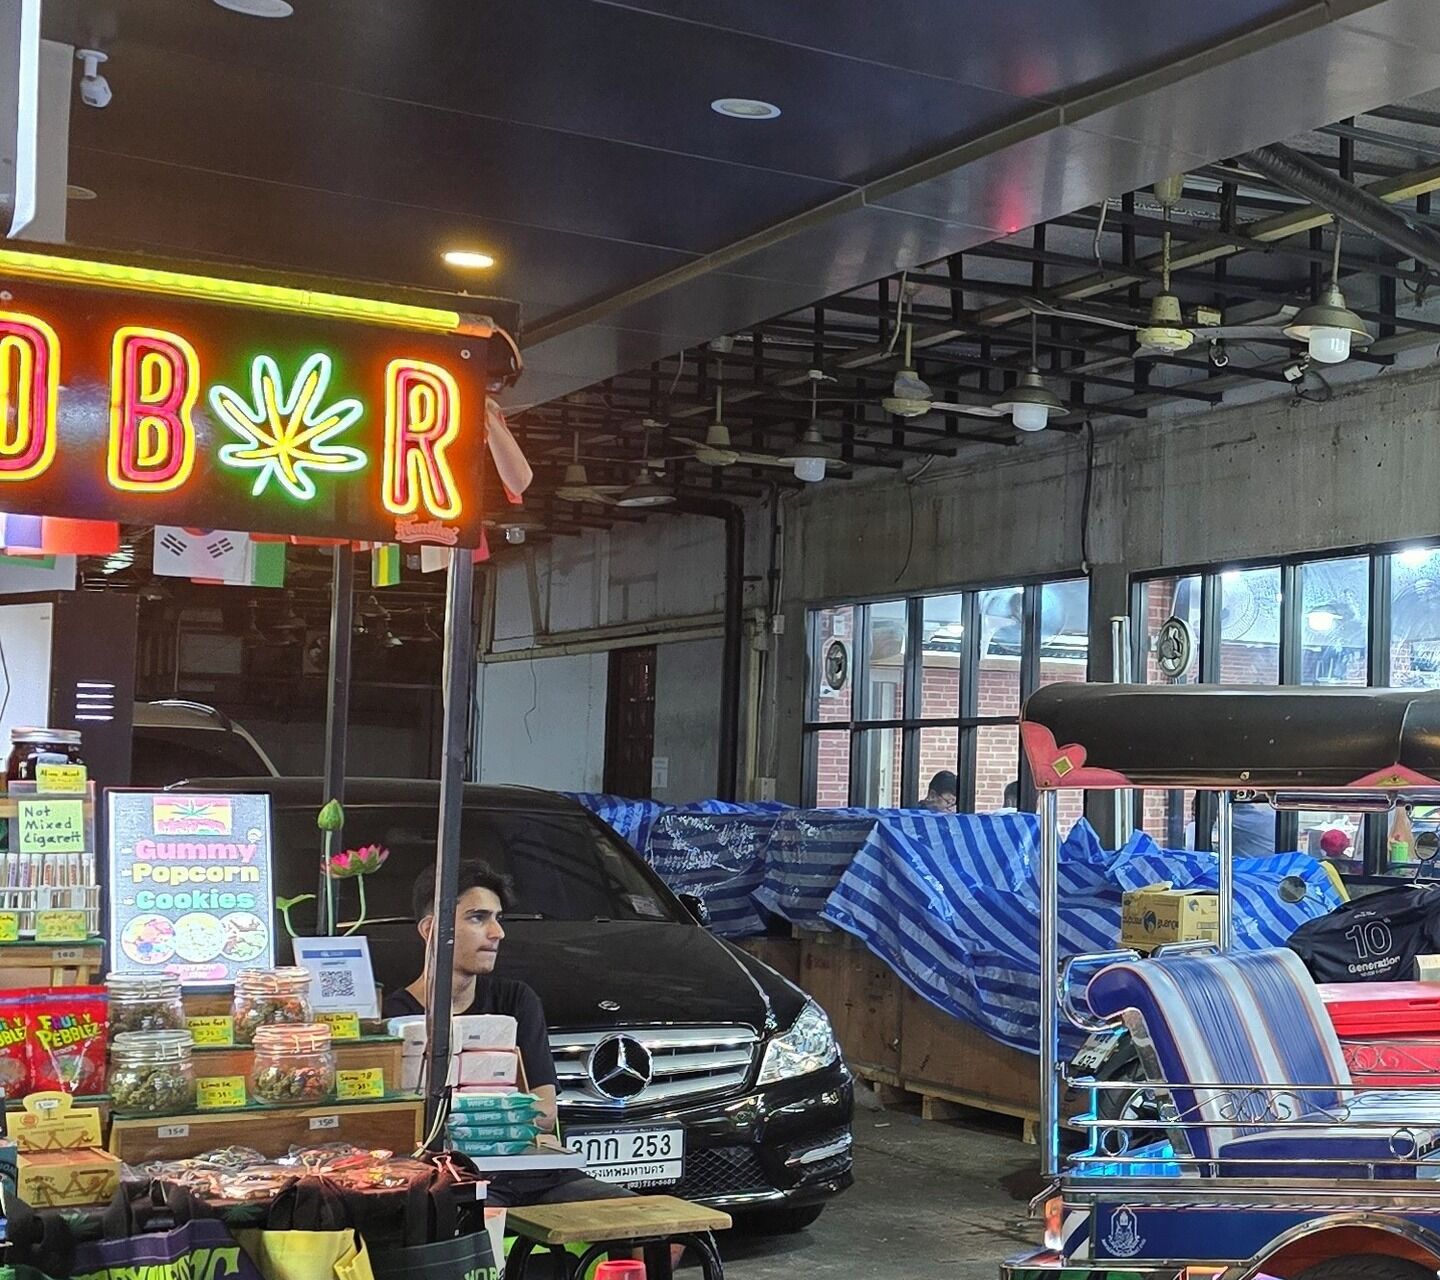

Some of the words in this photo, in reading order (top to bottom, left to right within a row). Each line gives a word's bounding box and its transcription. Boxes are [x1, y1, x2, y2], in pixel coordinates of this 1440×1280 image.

[24, 805, 51, 817] Not
[25, 816, 72, 829] Mixed
[134, 839, 257, 863] Gummy
[131, 862, 261, 886] Popcorn
[134, 887, 257, 911] Cookies
[1345, 921, 1392, 958] 10
[1347, 955, 1401, 973] Generation
[632, 1134, 671, 1158] 253
